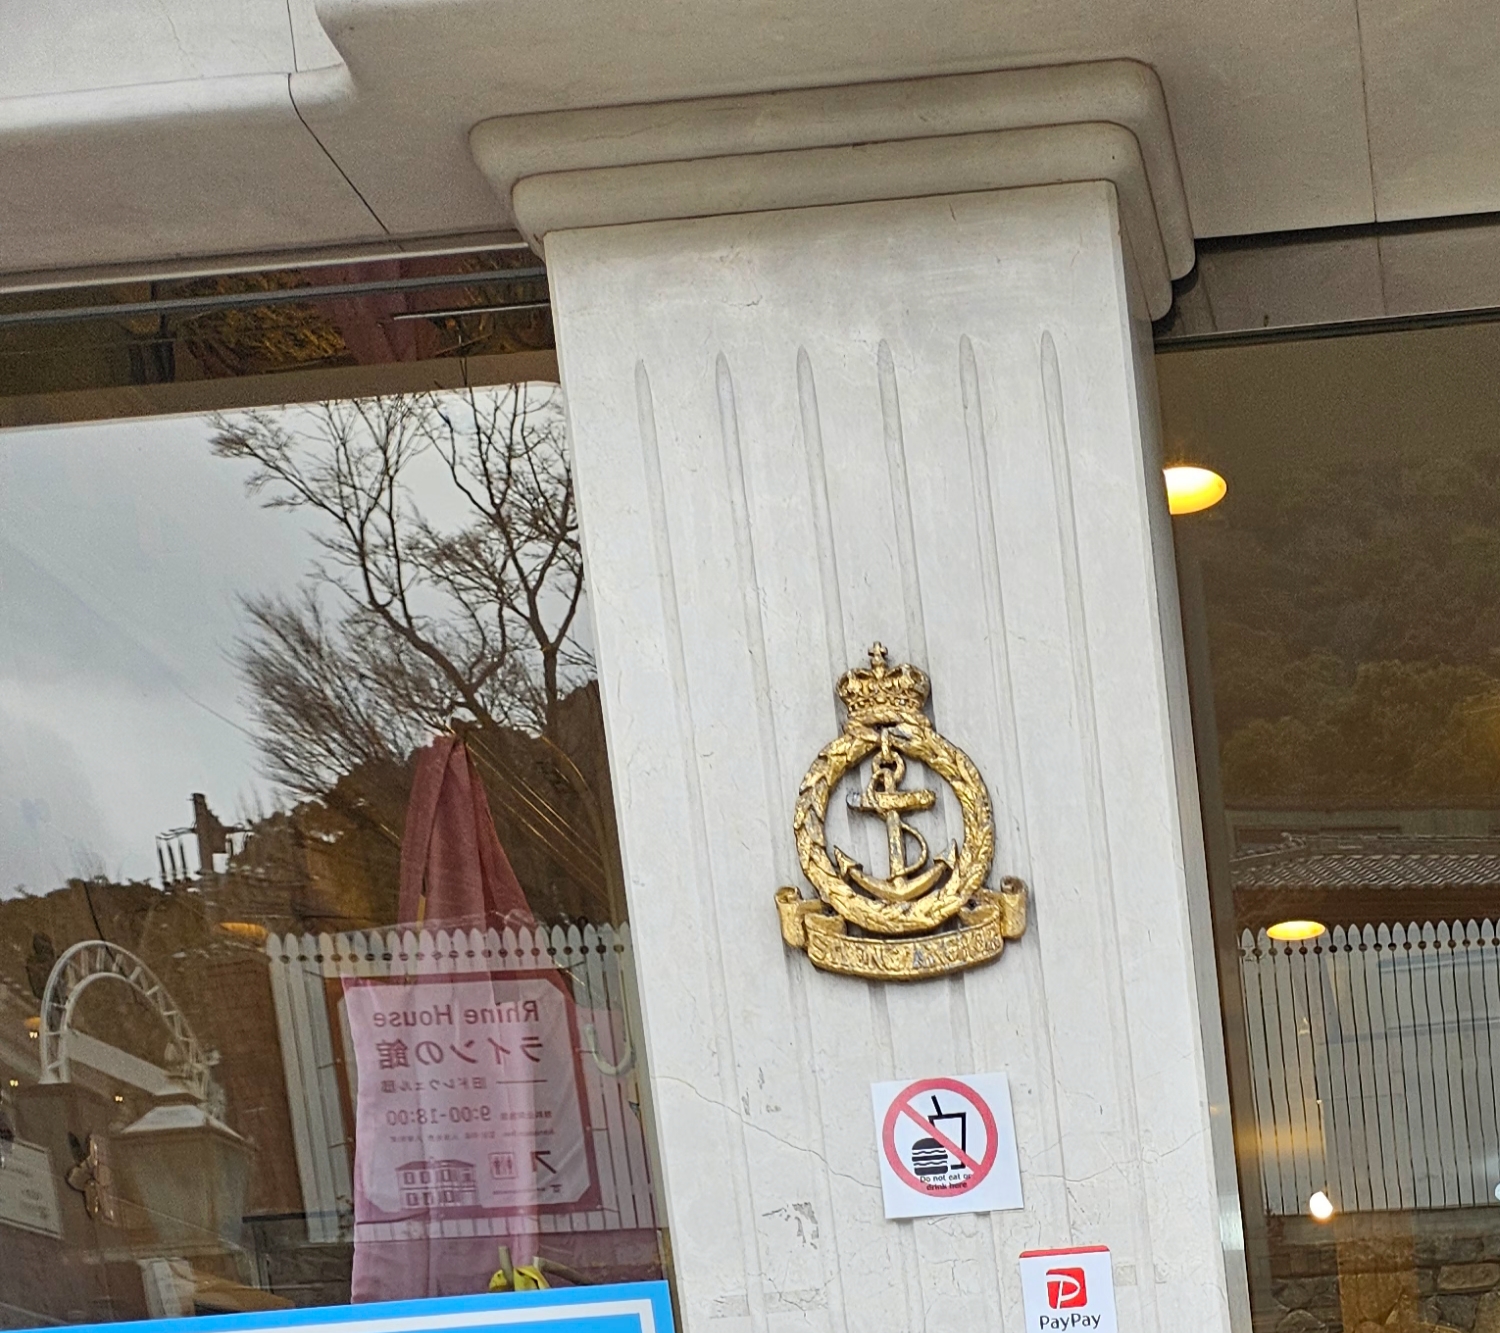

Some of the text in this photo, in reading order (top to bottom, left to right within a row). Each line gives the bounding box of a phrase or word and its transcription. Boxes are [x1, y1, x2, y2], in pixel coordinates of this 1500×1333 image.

[933, 1174, 946, 1182] not
[948, 1173, 961, 1181] eat
[926, 1183, 948, 1191] drink
[1039, 1313, 1101, 1332] PayPay
